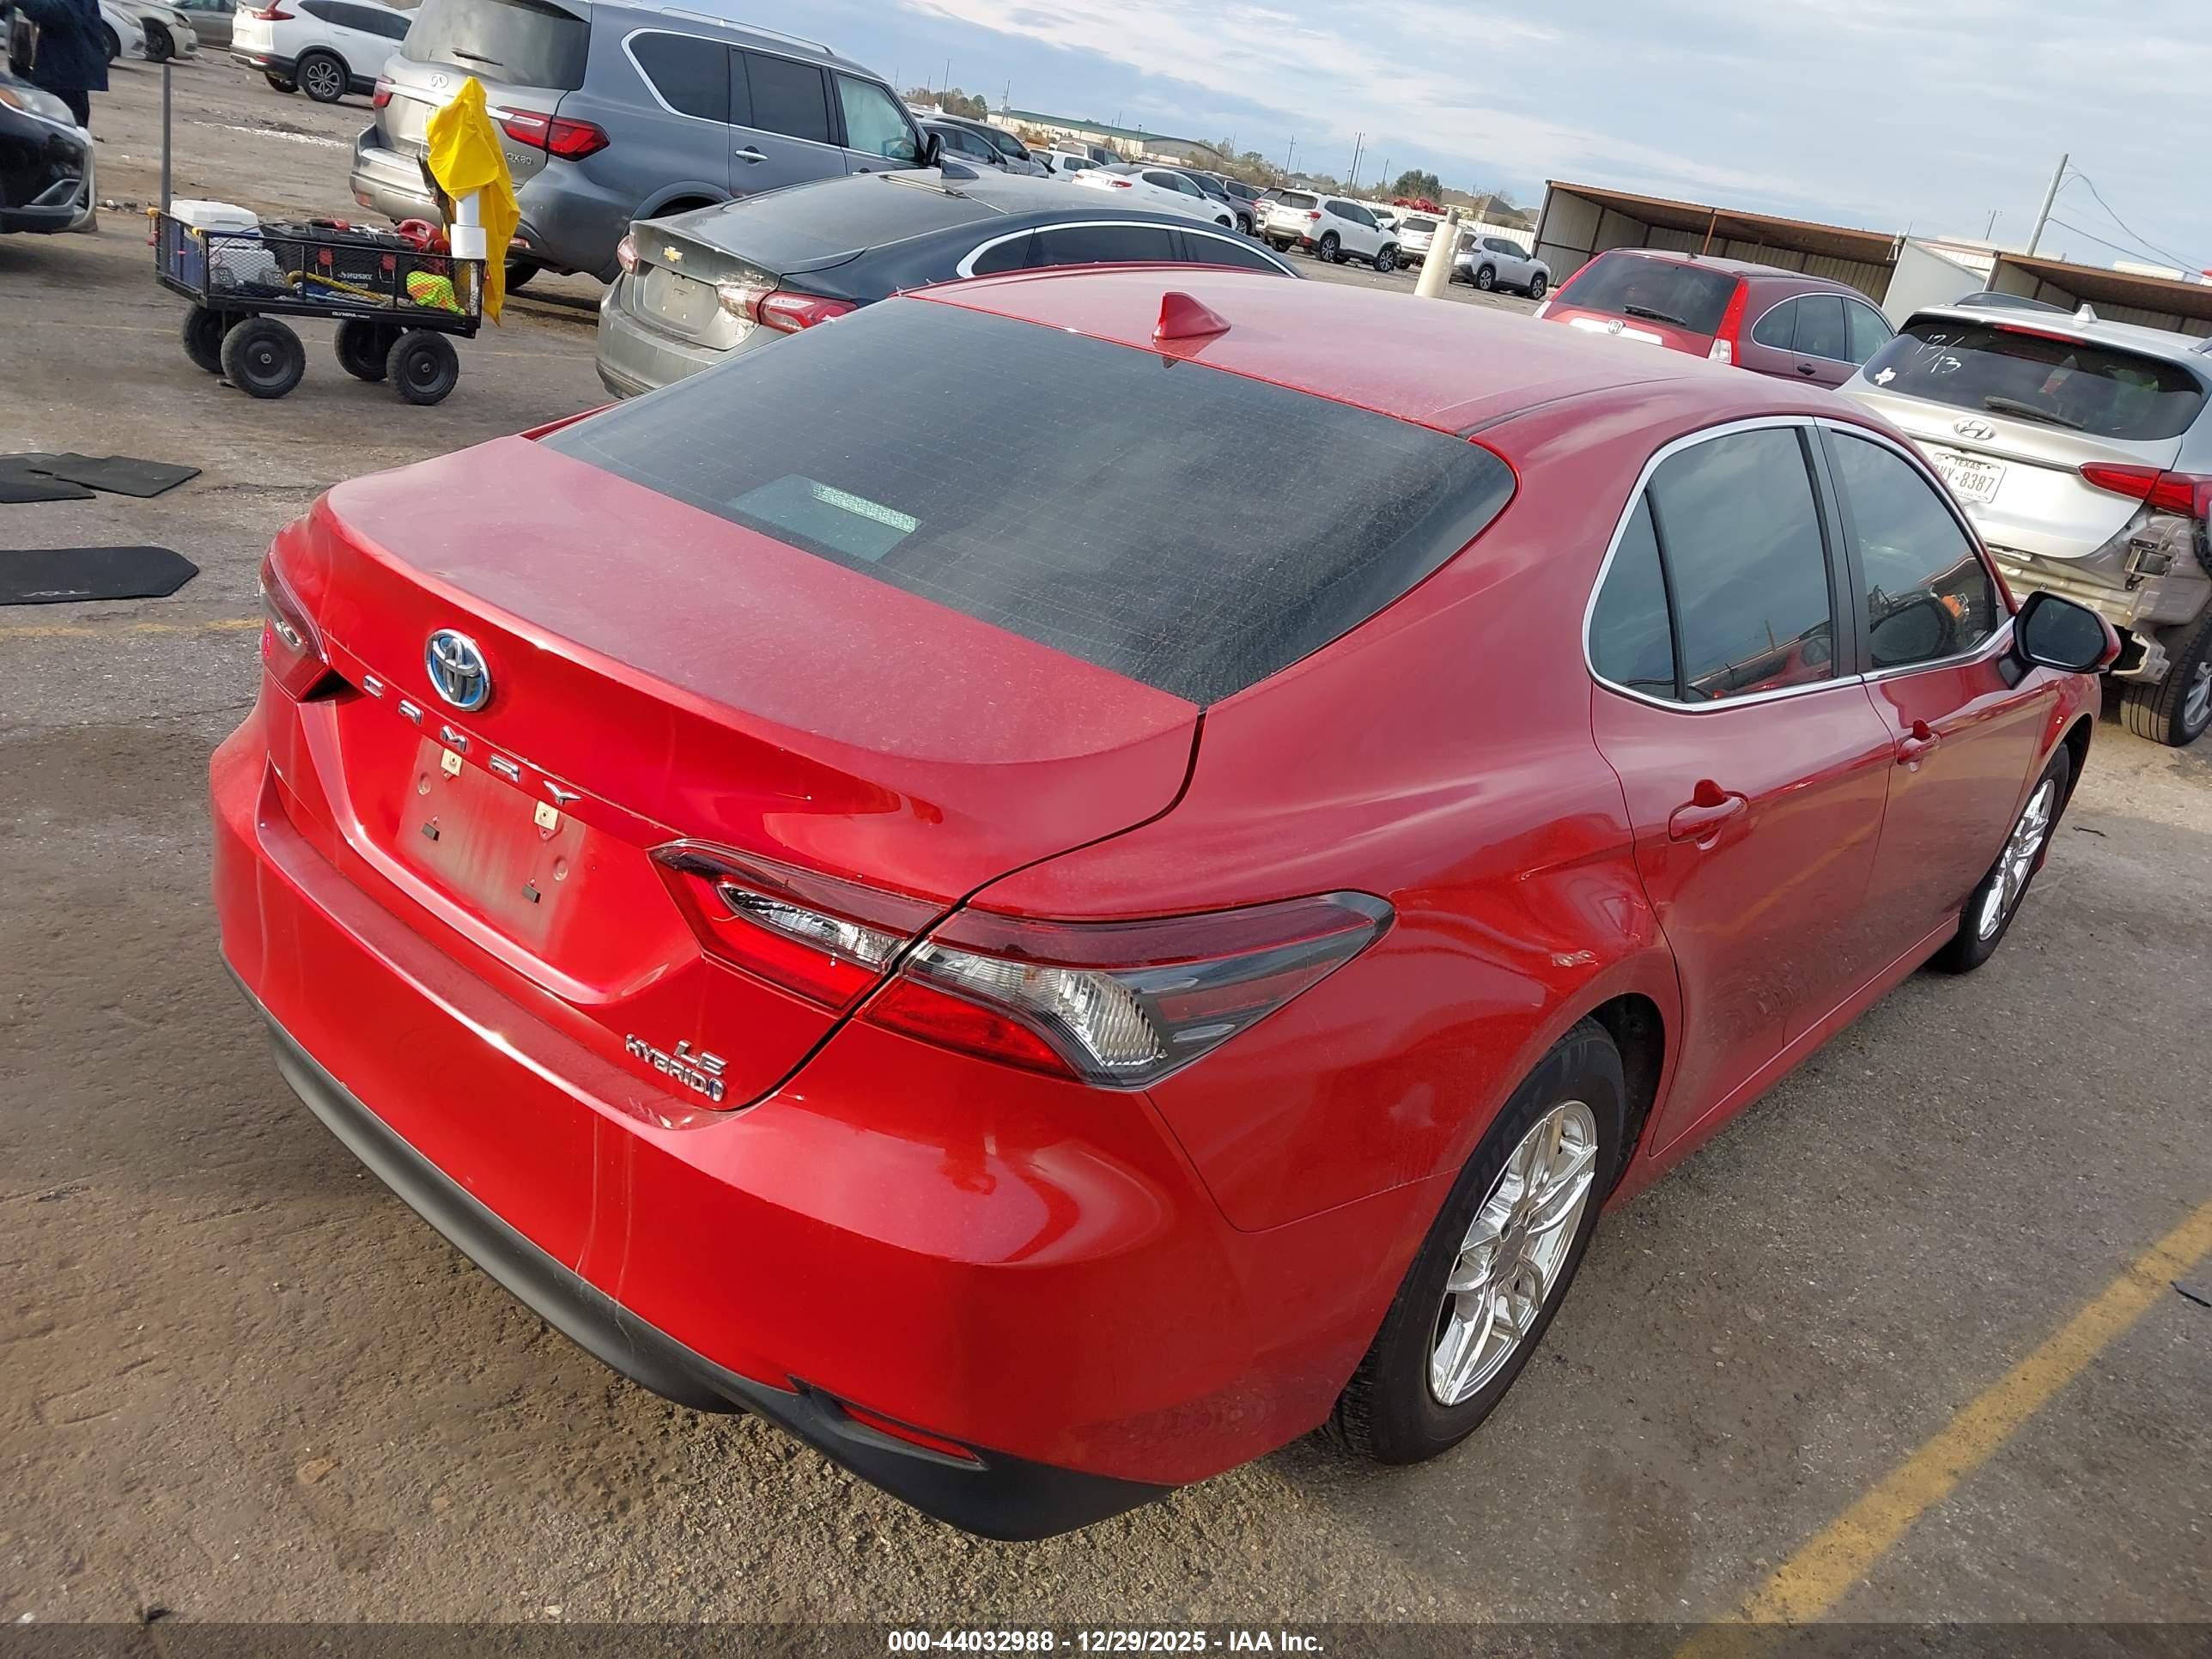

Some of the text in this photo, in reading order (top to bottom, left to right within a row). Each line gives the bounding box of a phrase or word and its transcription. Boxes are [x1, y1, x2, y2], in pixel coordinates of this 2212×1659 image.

[1954, 459, 1981, 471] TEXAS
[362, 674, 582, 805] CAMRY
[625, 1033, 707, 1093] HYBRID
[673, 1039, 728, 1076] LE
